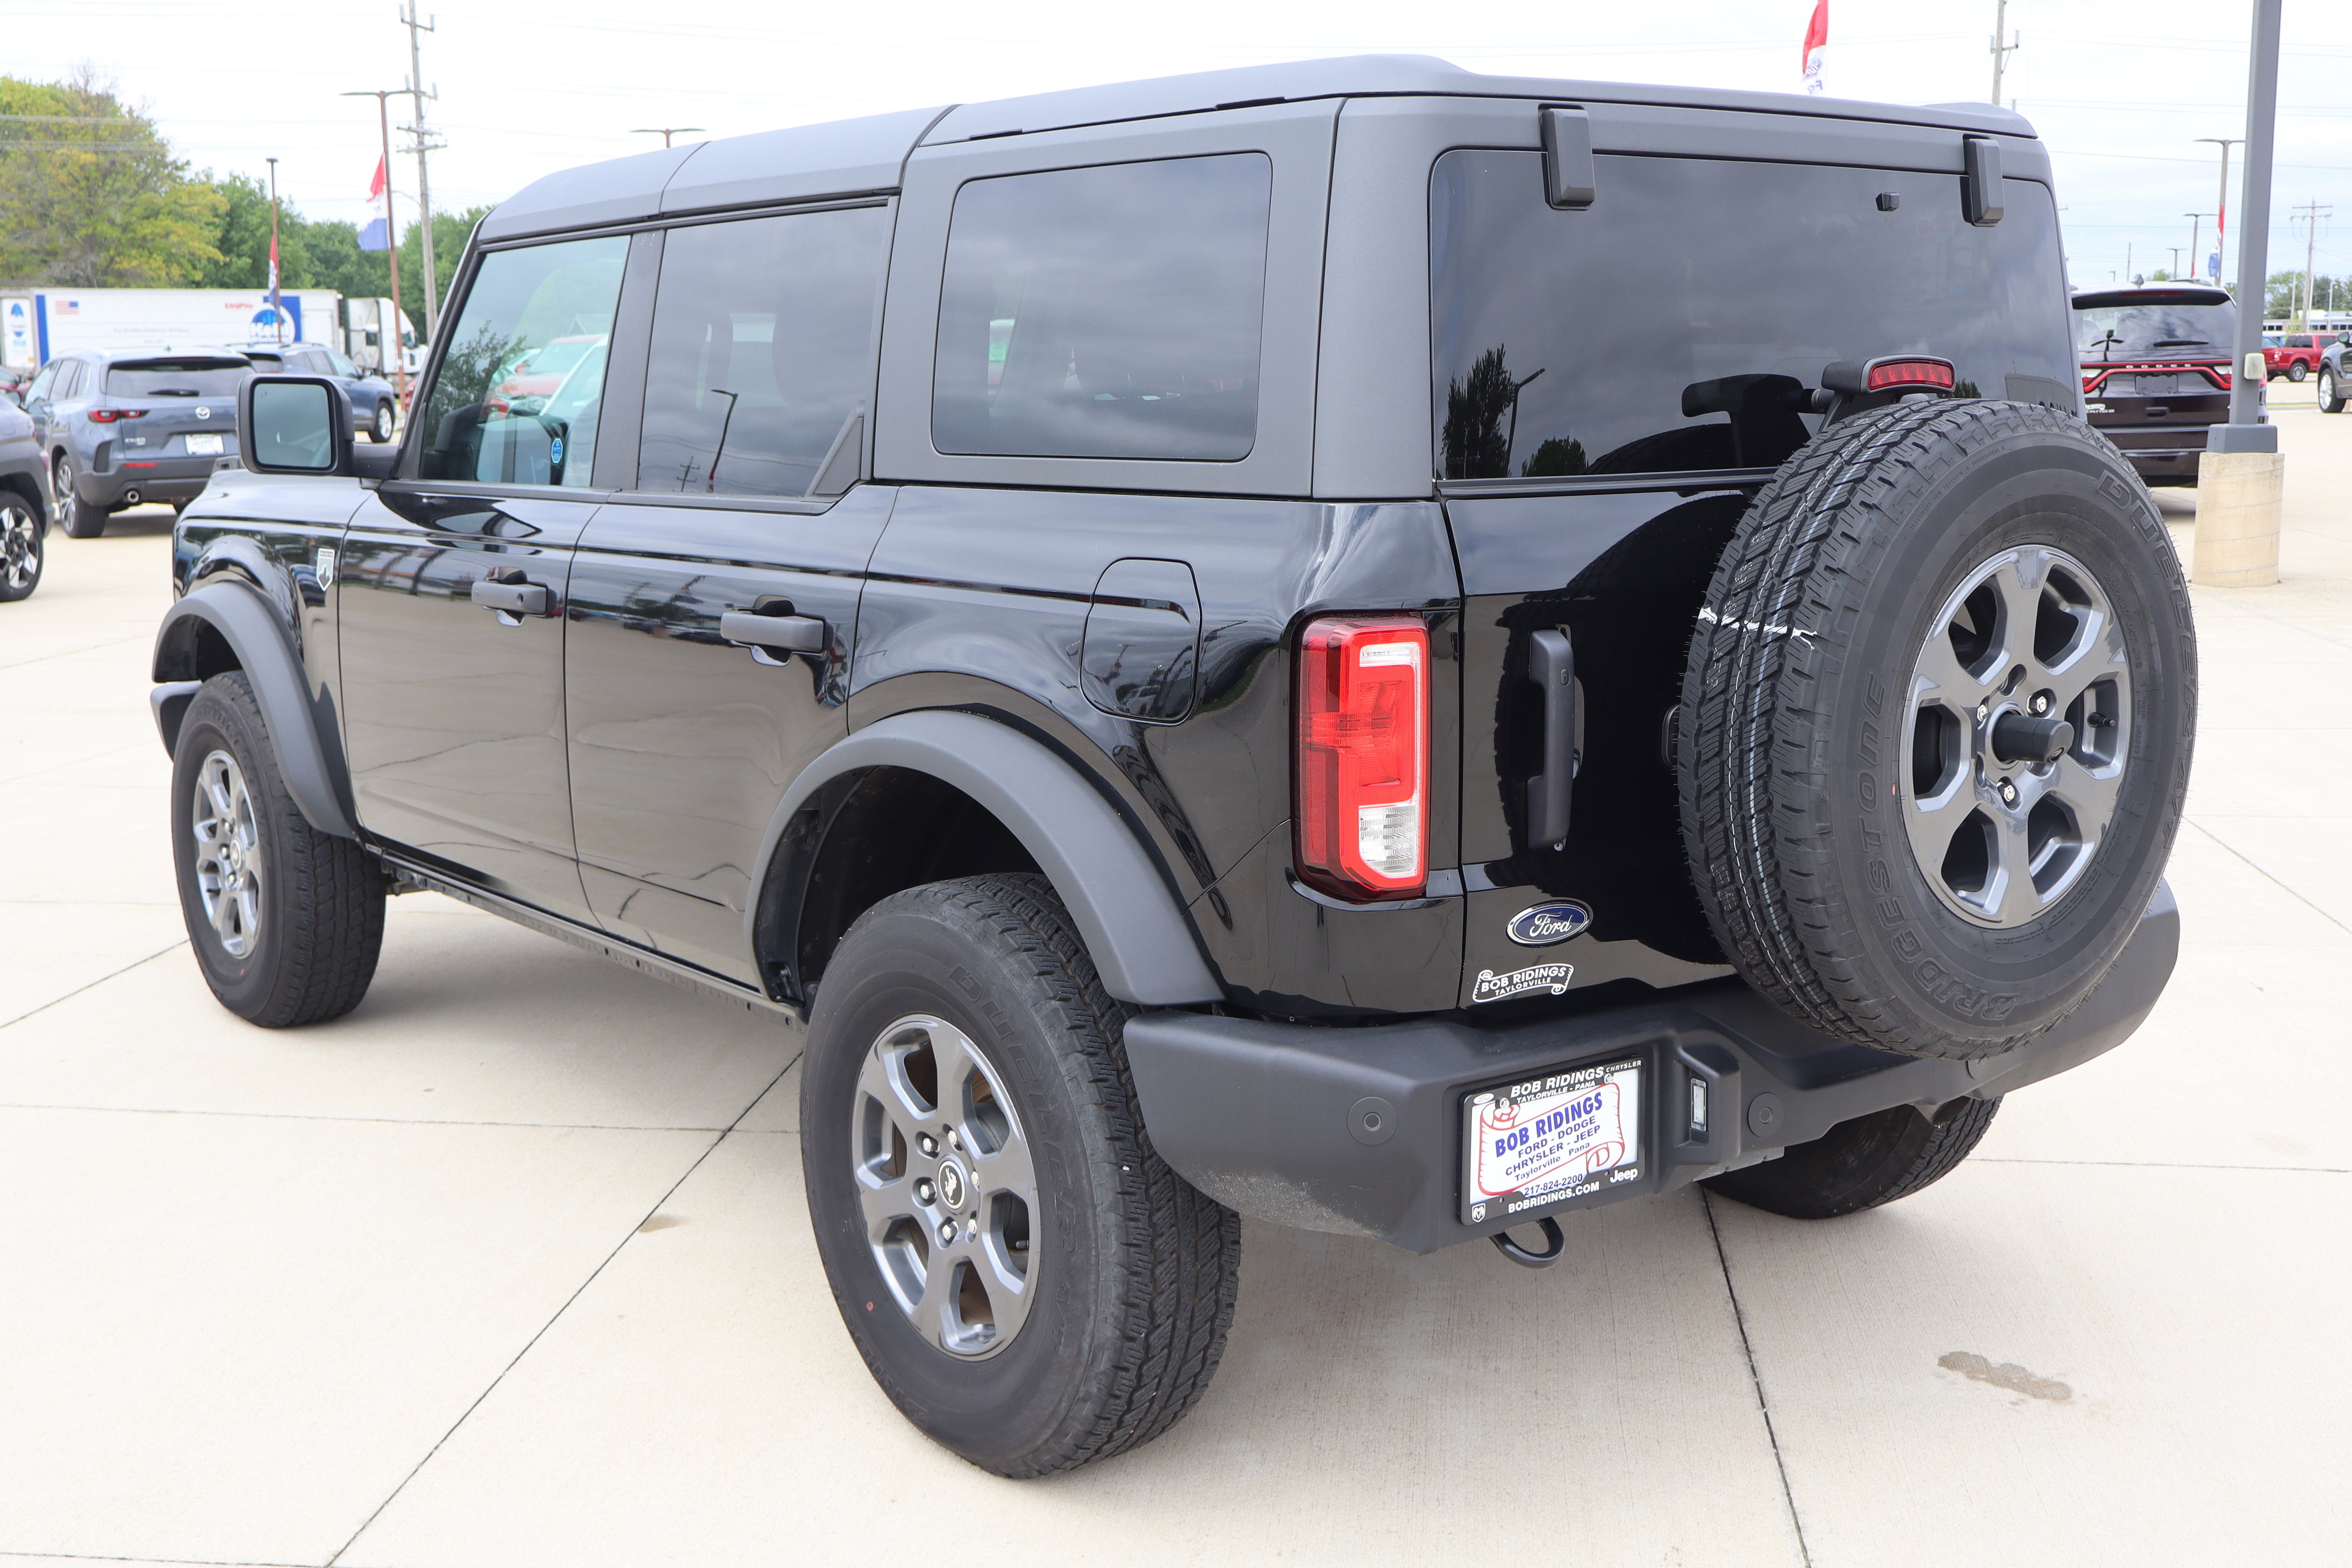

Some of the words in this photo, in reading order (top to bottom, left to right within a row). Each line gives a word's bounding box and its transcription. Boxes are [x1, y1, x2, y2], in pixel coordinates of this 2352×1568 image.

[2096, 470, 2197, 741] DUELER
[1856, 670, 2021, 1020] BRIDGESTONE
[1529, 911, 1574, 937] Ford
[1481, 977, 1509, 993] BOB
[1513, 967, 1567, 984] RIDINGS
[1495, 977, 1551, 996] TAYLORVILLE
[1510, 1080, 1541, 1098] BOB
[1546, 1067, 1604, 1090] RIDINGS
[1606, 1060, 1642, 1073] CHRYSLER
[1517, 1087, 1568, 1104] TAYLORVILLE
[1575, 1080, 1596, 1091] PANA
[946, 964, 1077, 1254] DUELER
[1495, 1127, 1530, 1158] BOB
[1536, 1091, 1603, 1138] RIDINGS
[1505, 1143, 1564, 1176] CHRYSLER
[1574, 1125, 1600, 1144] JEEP
[1518, 1139, 1548, 1159] FORD
[1558, 1116, 1596, 1139] DODGE
[1515, 1155, 1561, 1182] Taylorville
[1568, 1142, 1590, 1156] Pana
[1610, 1168, 1638, 1184] Jeep
[1508, 1181, 1599, 1214] BOBRIDINGS.COM
[1524, 1174, 1583, 1197] 217-824-2200
